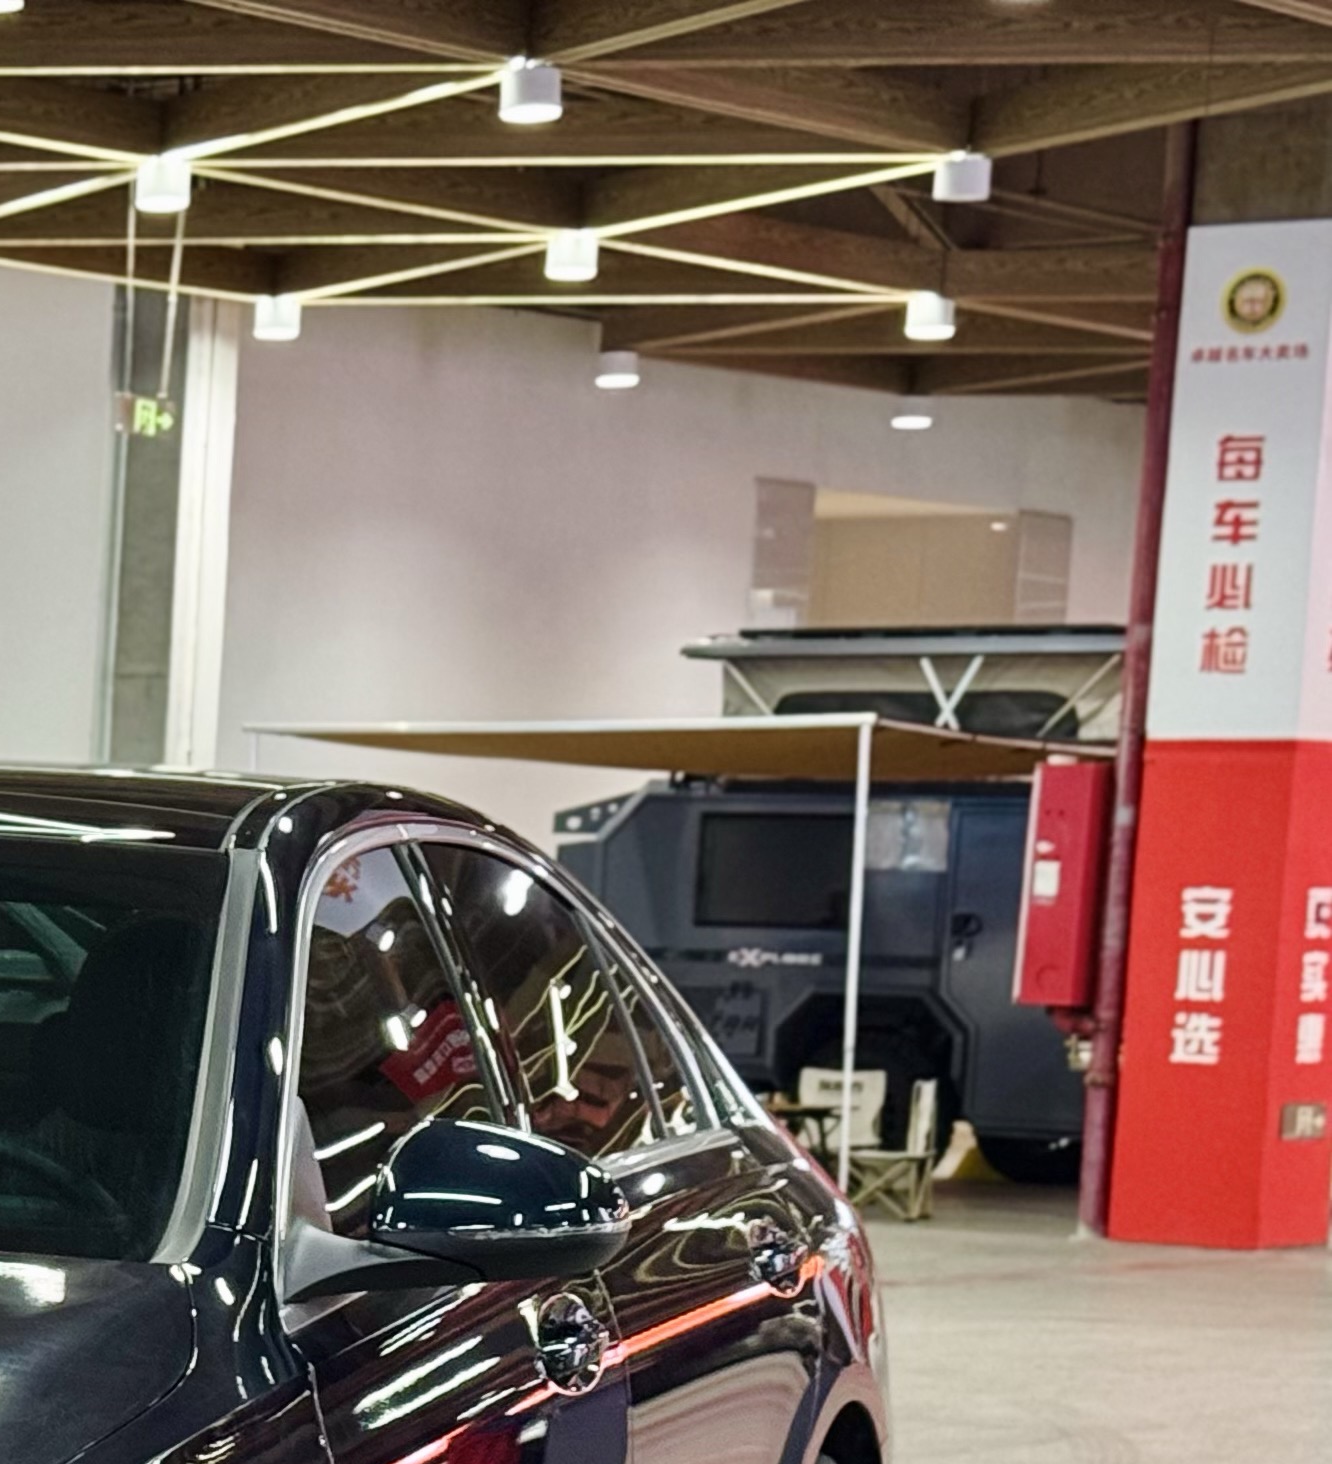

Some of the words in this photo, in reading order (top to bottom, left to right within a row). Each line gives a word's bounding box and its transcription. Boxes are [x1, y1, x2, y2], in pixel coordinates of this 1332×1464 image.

[1200, 434, 1266, 674] 每车必检
[1169, 885, 1233, 1065] 安心选
